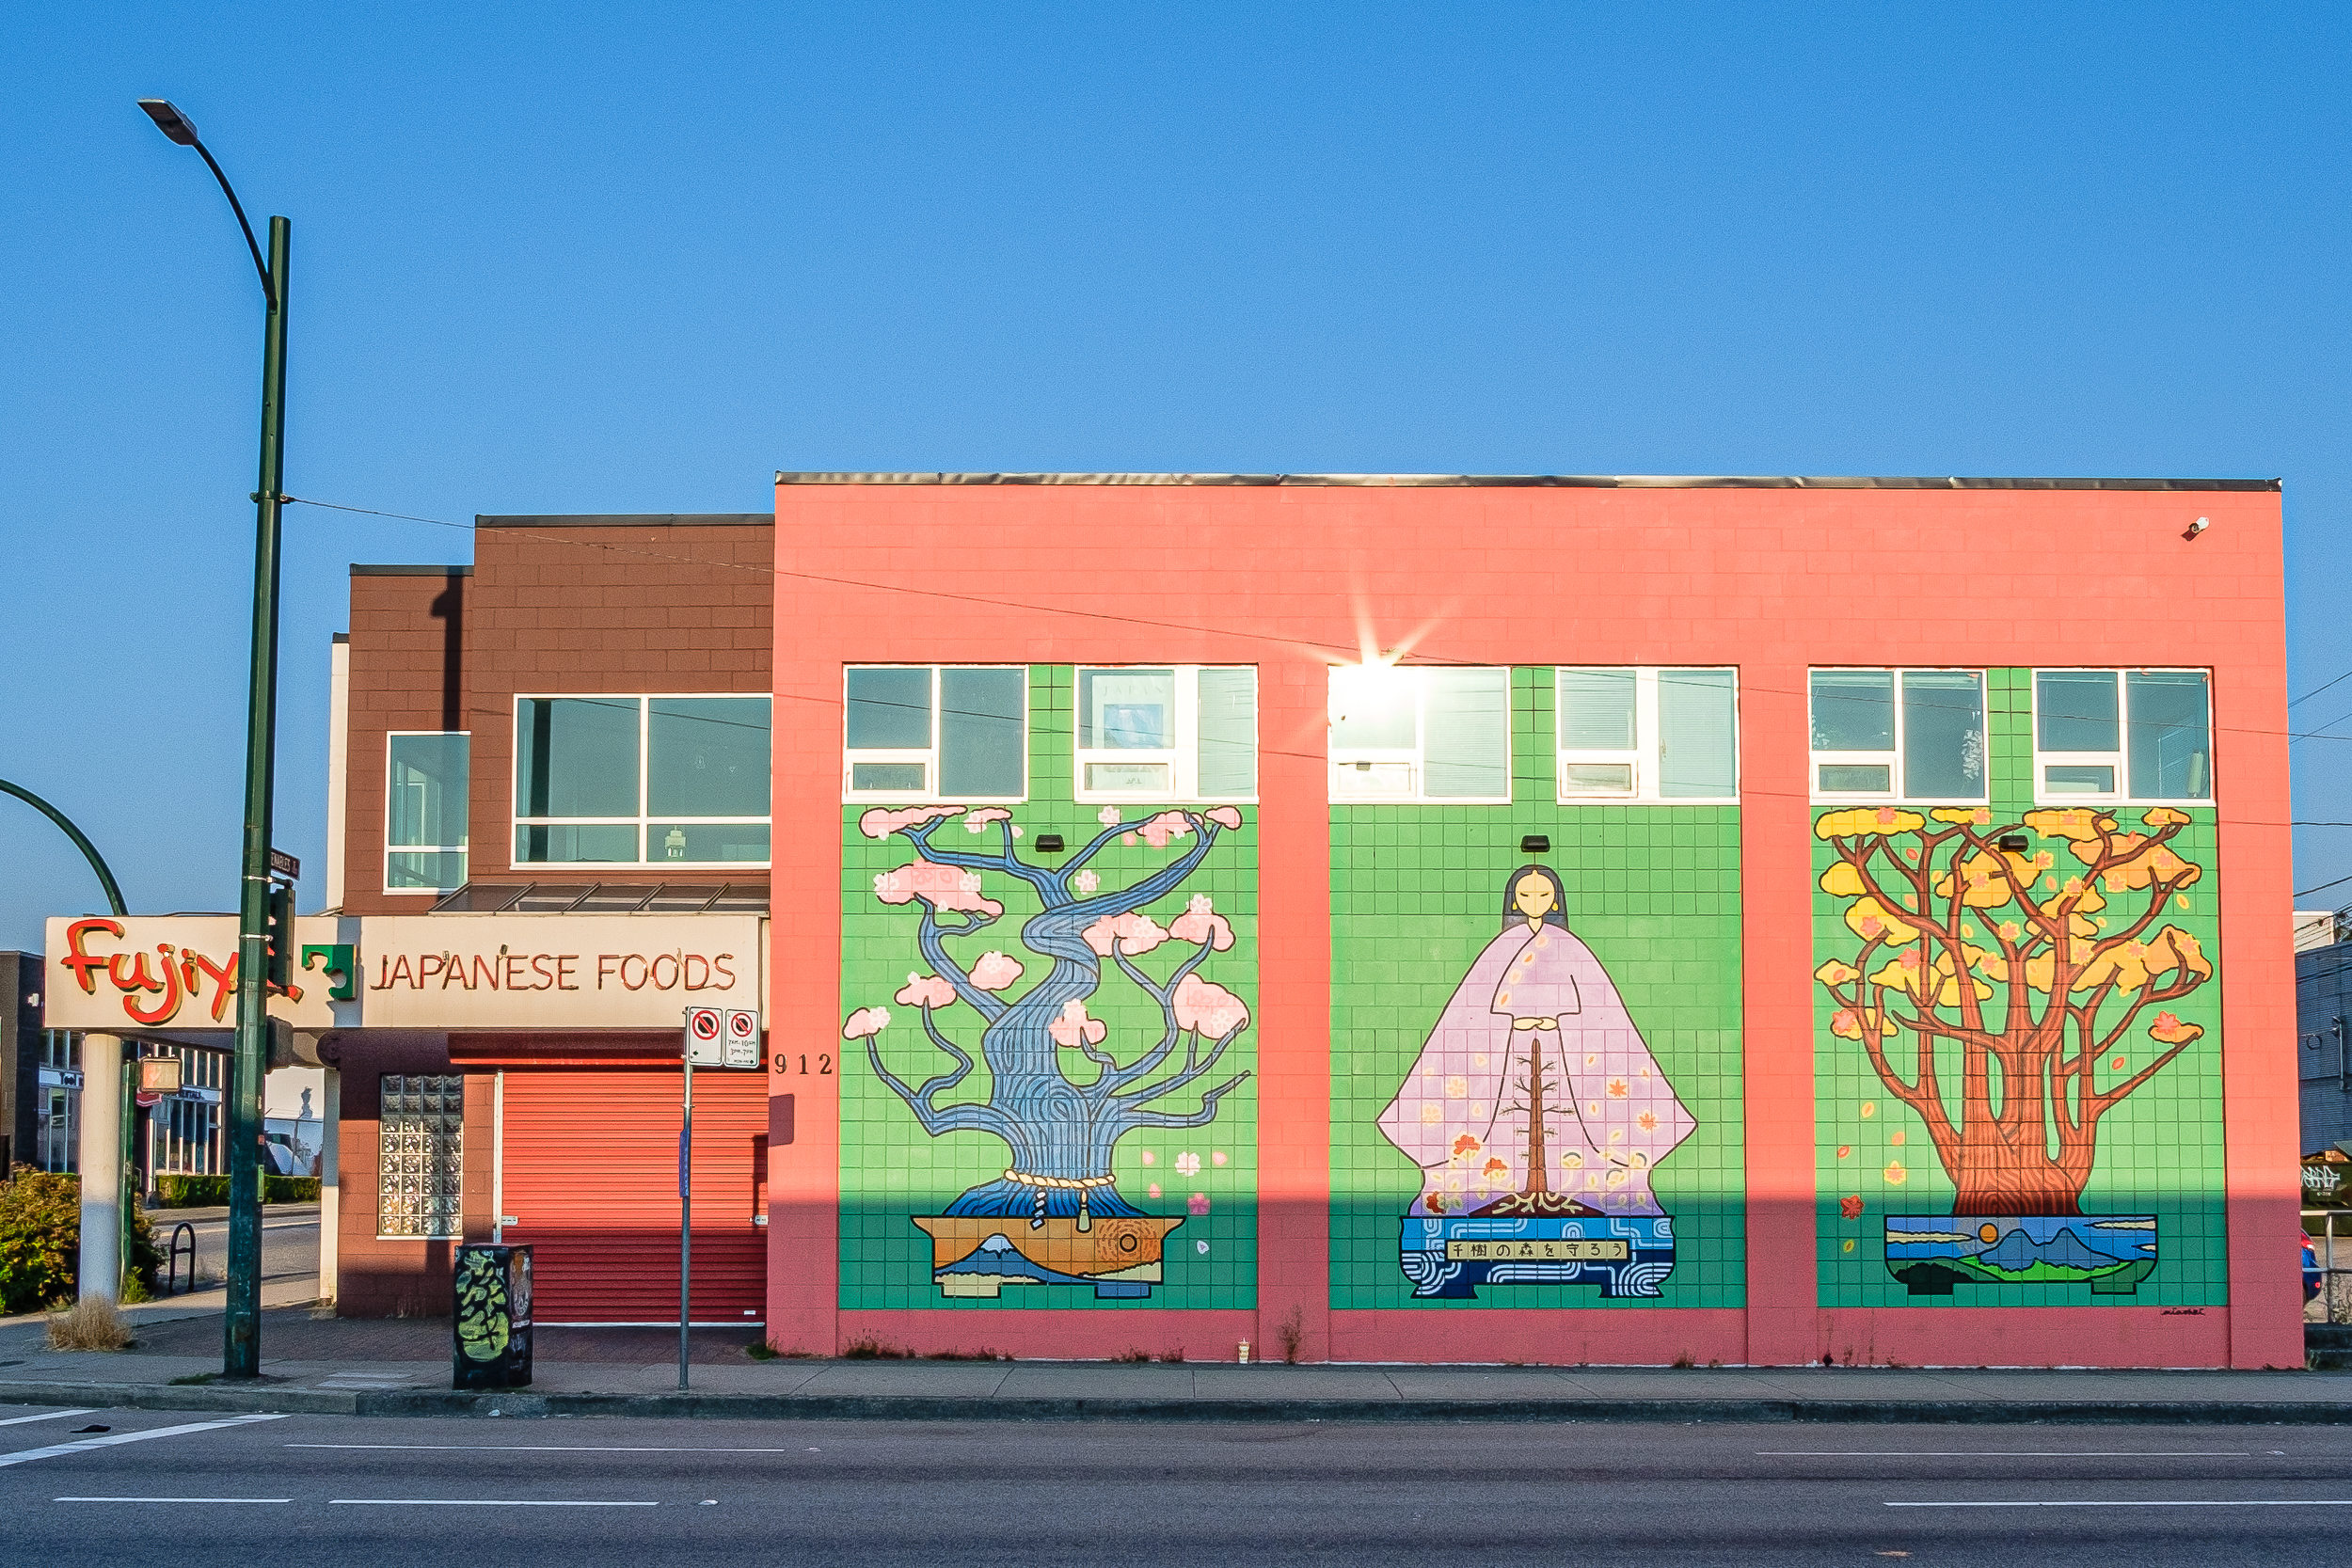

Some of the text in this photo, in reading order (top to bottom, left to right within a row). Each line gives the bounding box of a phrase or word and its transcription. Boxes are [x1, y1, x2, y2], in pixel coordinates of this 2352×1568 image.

[1104, 686, 1163, 696] JAPAN
[271, 851, 291, 873] ENABLES
[370, 953, 736, 990] JAPANESE FOODS
[774, 1053, 833, 1074] 912
[1453, 1243, 1622, 1257] 千樹の森を守ろう
